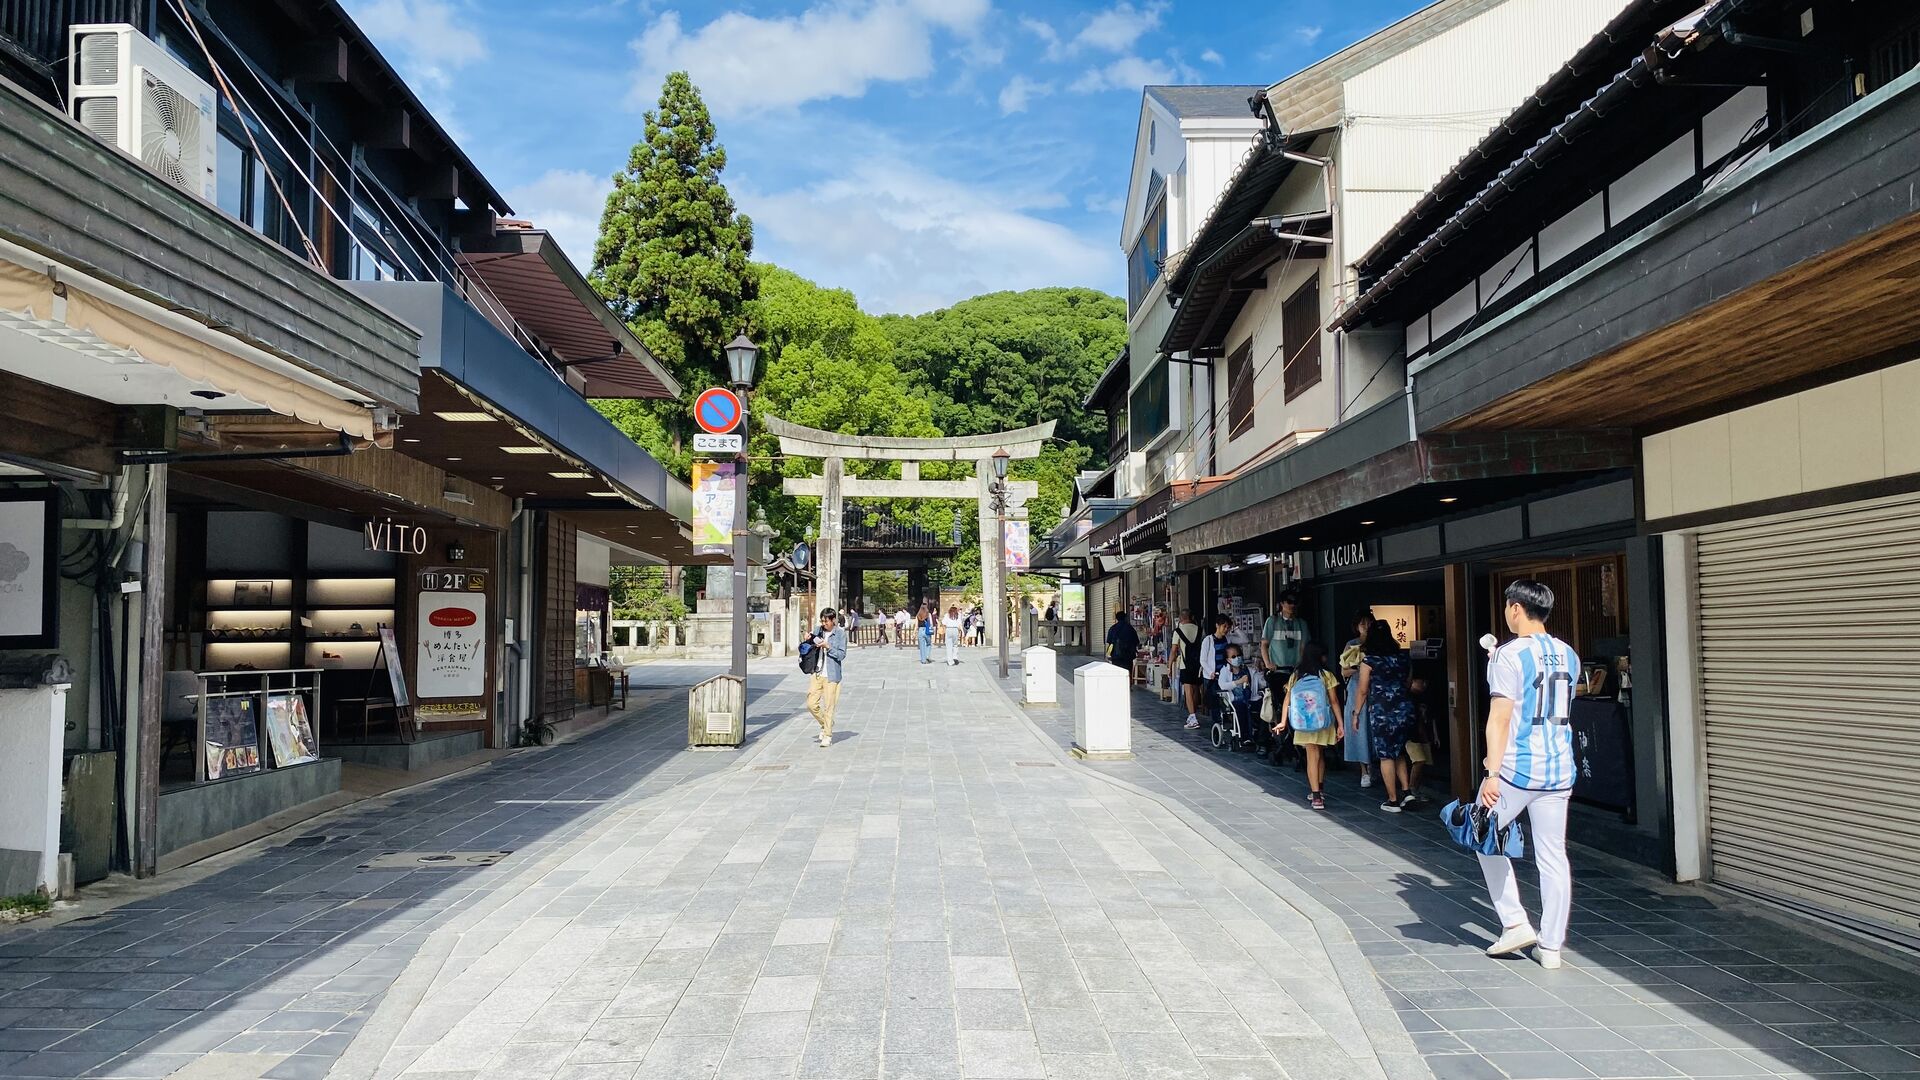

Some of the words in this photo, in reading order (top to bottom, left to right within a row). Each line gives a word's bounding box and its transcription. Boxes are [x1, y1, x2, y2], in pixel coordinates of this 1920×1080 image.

[697, 438, 738, 448] ここまで
[1323, 541, 1365, 569] KAGURA
[443, 573, 465, 589] 2F
[443, 630, 462, 639] 博多
[433, 642, 471, 650] めんたい
[1538, 654, 1565, 666] MESSI
[1531, 672, 1573, 725] 10
